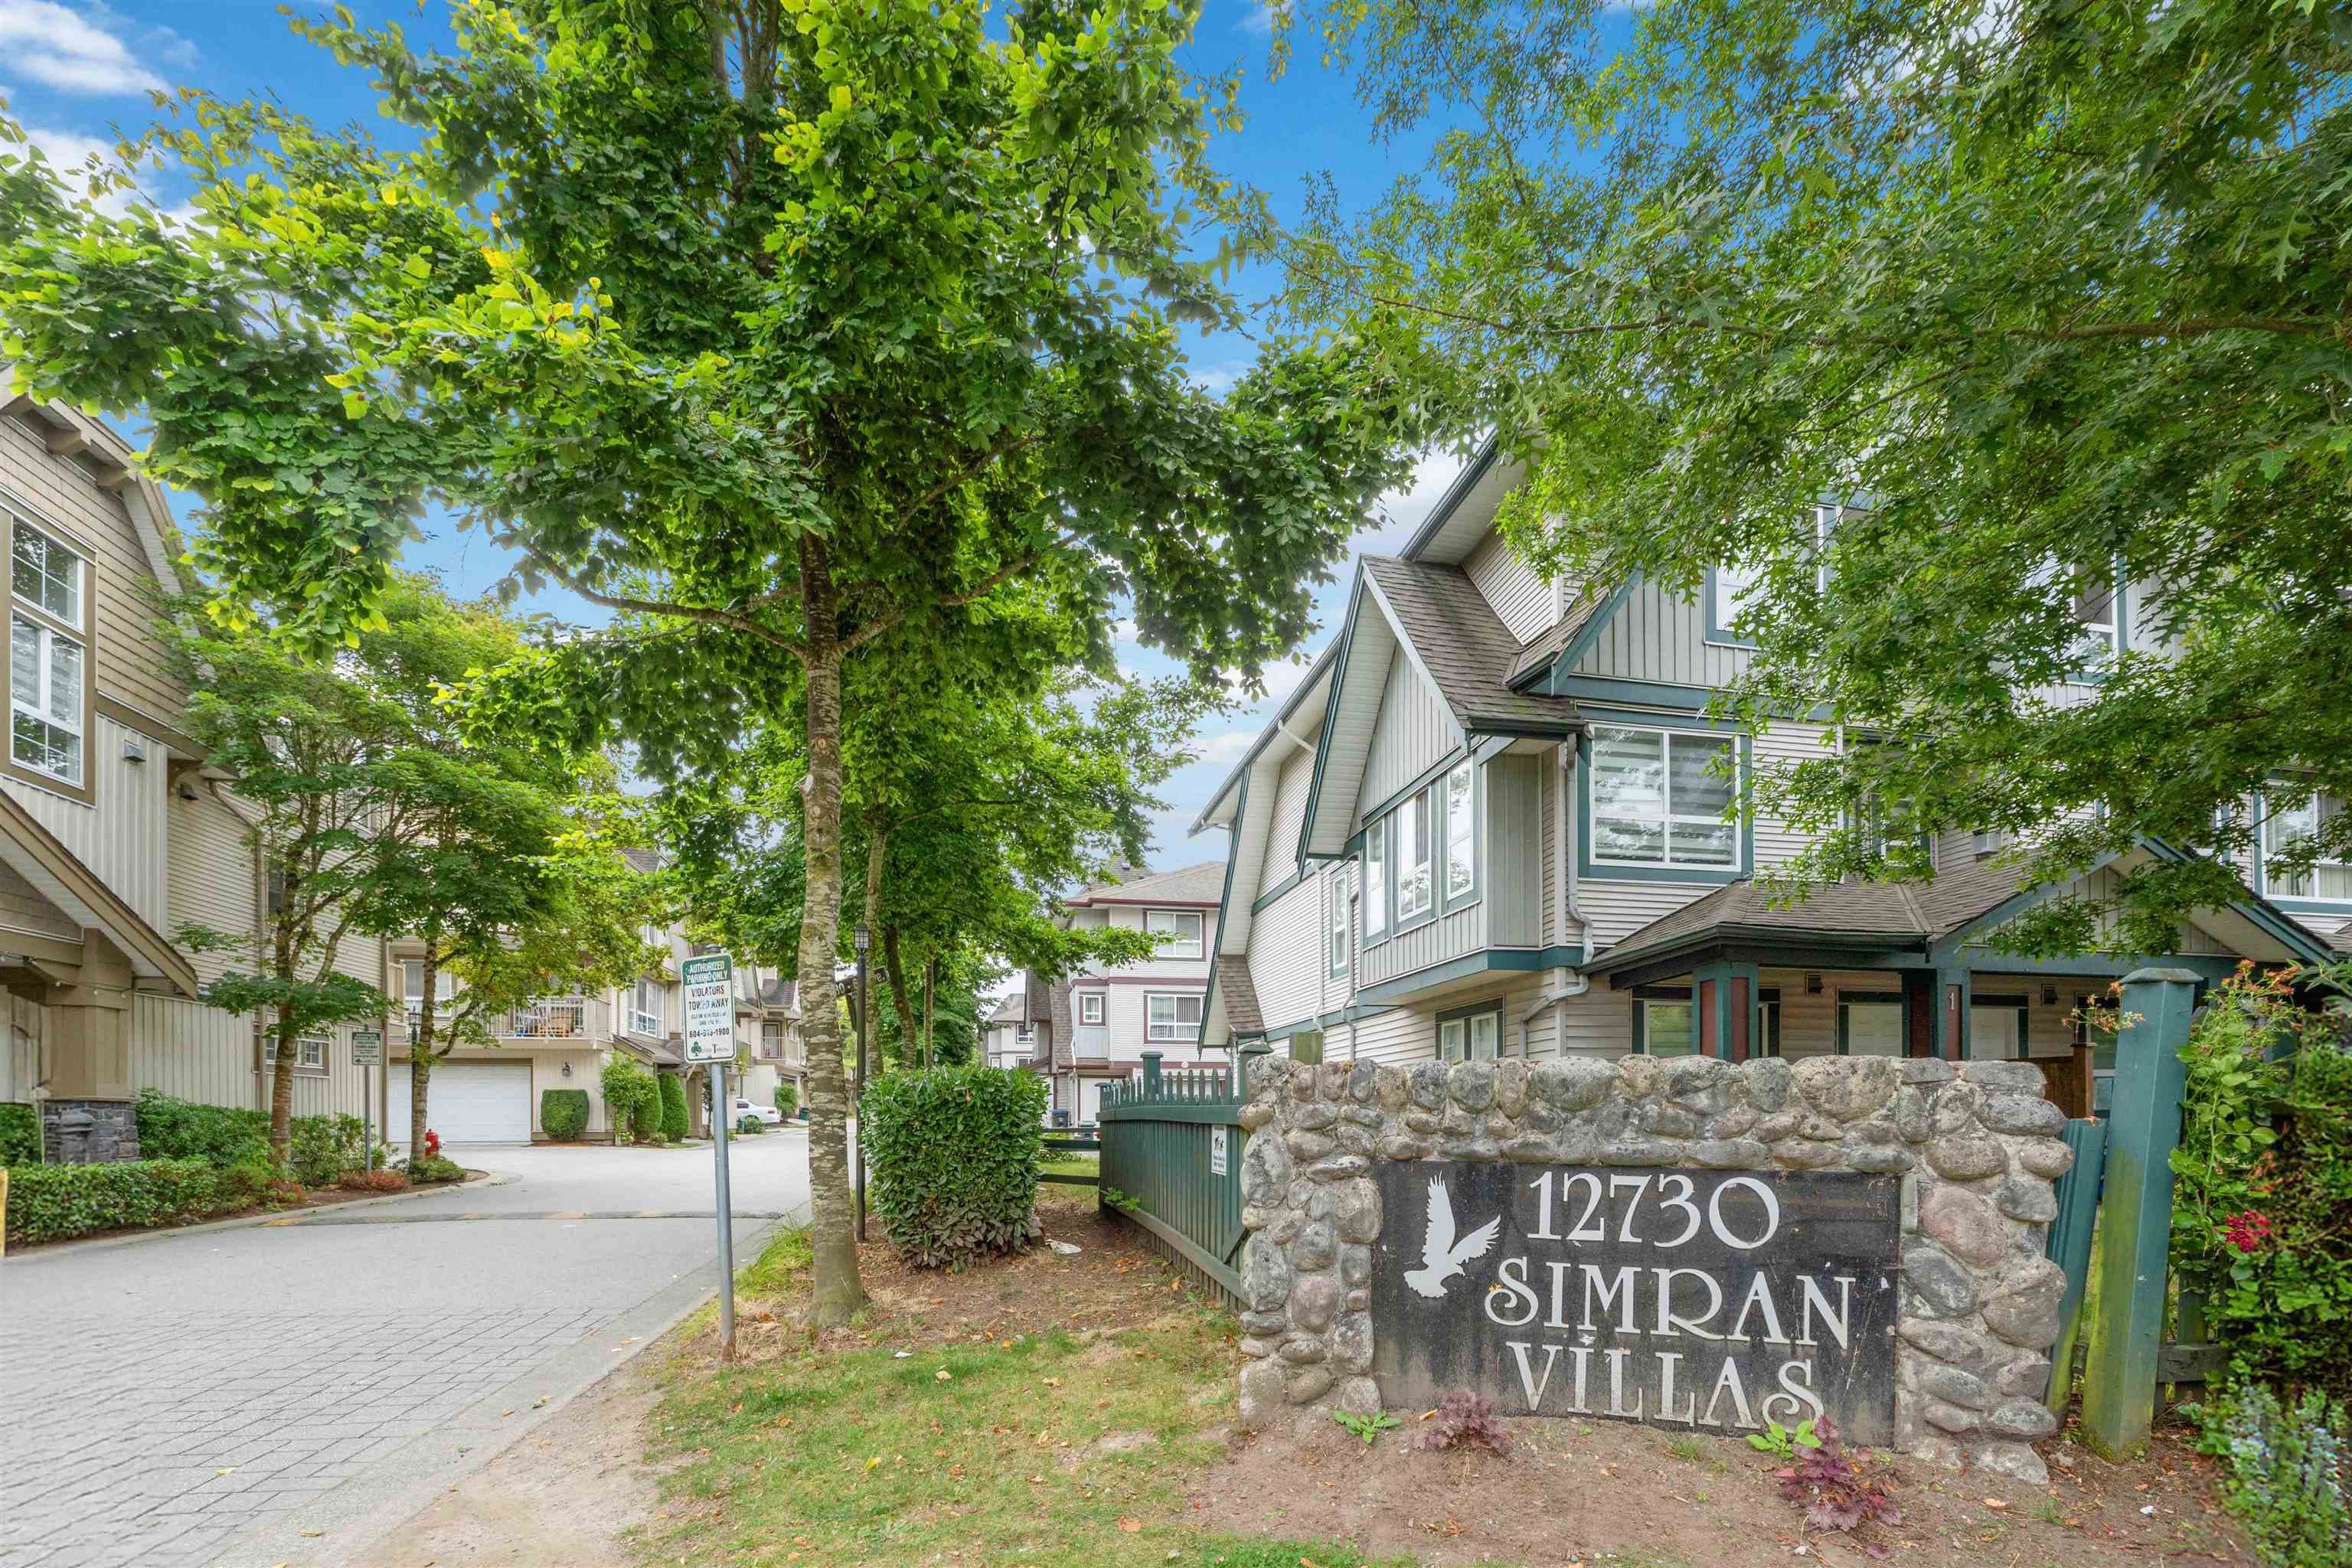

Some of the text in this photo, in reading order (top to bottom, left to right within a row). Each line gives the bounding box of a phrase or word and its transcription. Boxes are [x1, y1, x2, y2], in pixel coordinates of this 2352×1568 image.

[689, 961, 724, 974] AUTHORIZED
[687, 969, 728, 984] PARKING ONLY
[691, 985, 724, 998] VIOLATORS
[711, 998, 729, 1008] AWAY
[1527, 1171, 1779, 1250] 12730
[1484, 1256, 1856, 1349] SIMRAN
[1505, 1341, 1825, 1434] VILLAS
